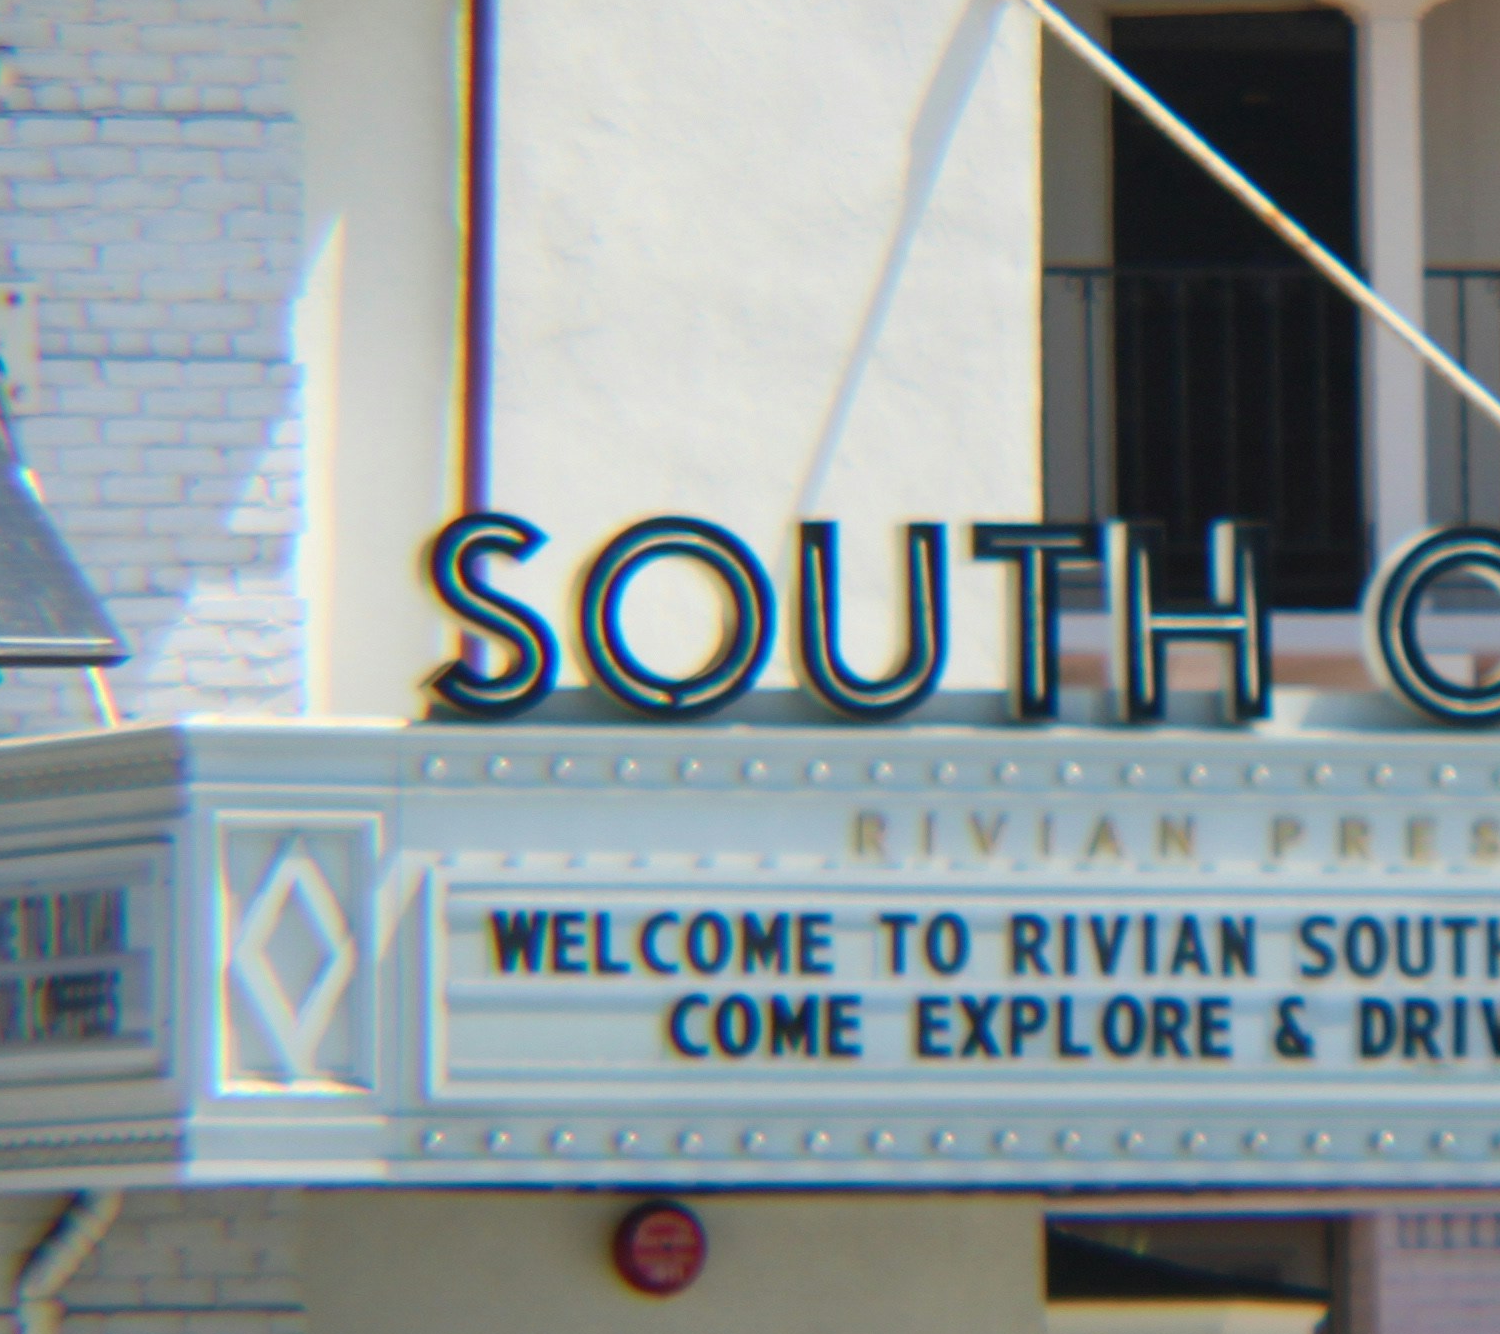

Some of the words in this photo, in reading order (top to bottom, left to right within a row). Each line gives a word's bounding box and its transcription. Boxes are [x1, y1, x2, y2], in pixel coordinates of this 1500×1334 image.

[425, 512, 1272, 721] SOUTH
[854, 812, 1196, 859] RIVIAN
[490, 910, 834, 976] WELCOME
[880, 912, 971, 976] TO
[1011, 914, 1255, 977] RIVIAN
[667, 993, 863, 1058] COME
[916, 995, 1233, 1058] EXPLORE
[1274, 996, 1315, 1059] &
